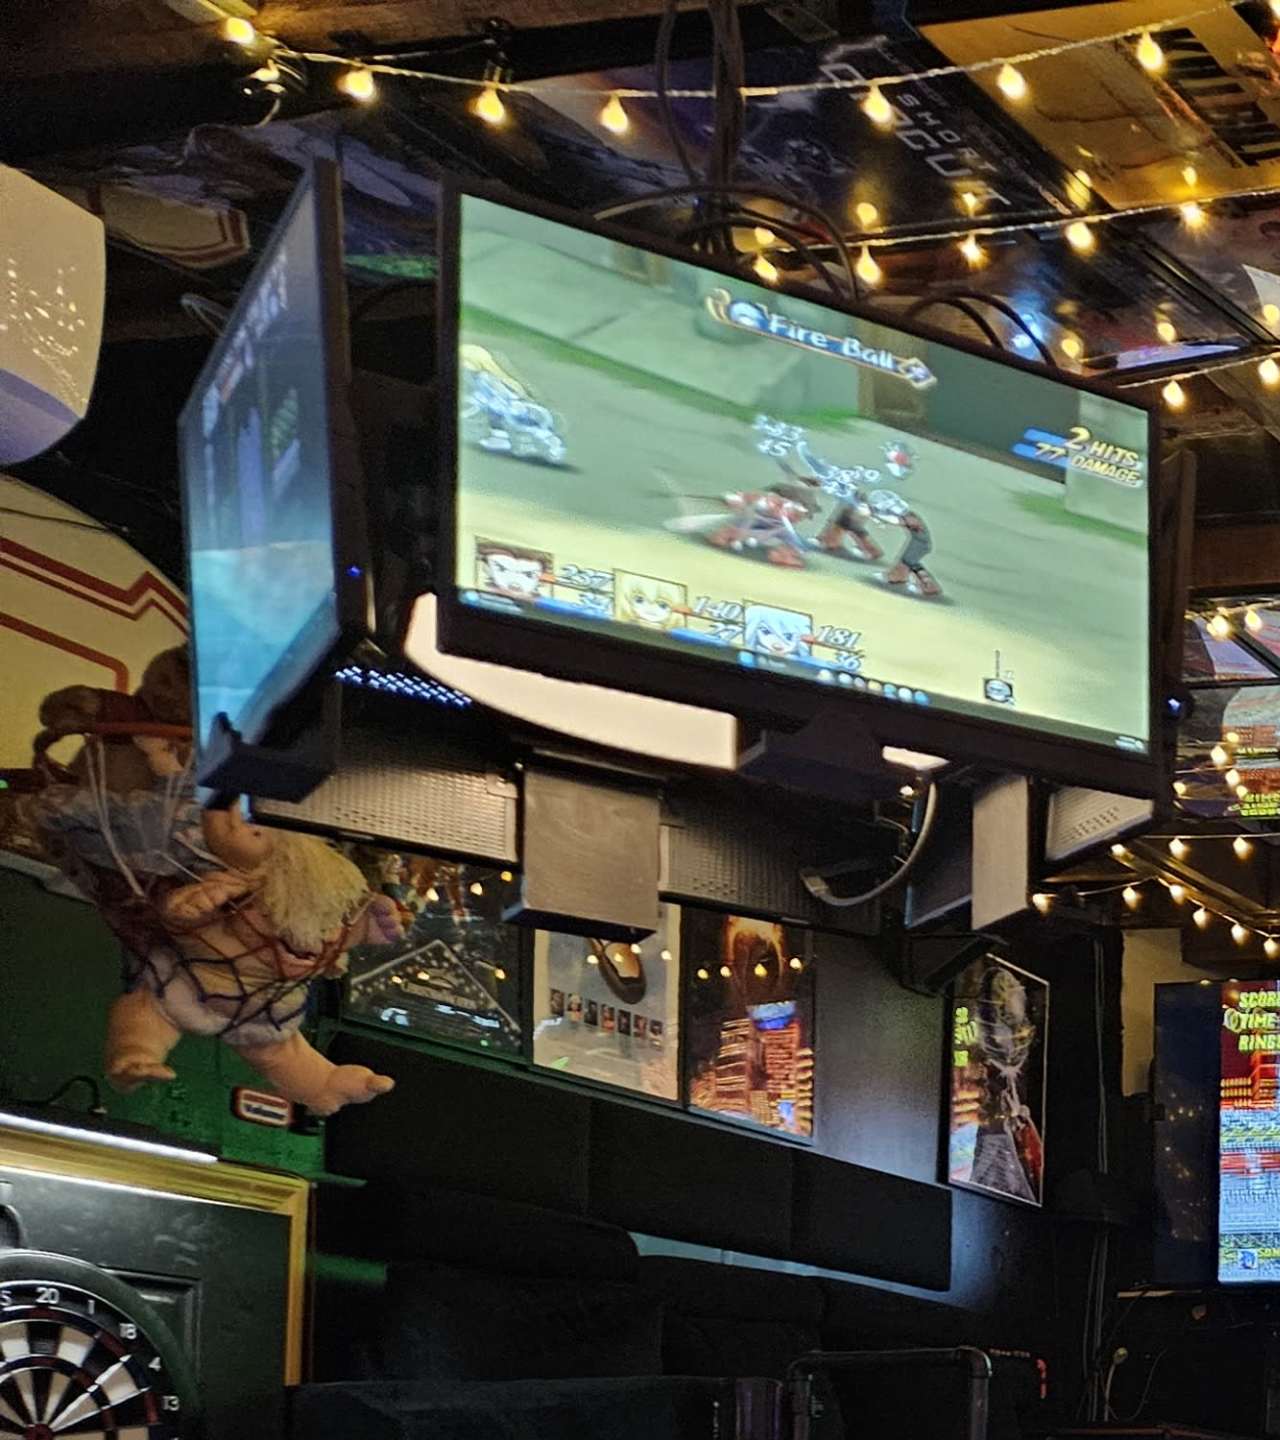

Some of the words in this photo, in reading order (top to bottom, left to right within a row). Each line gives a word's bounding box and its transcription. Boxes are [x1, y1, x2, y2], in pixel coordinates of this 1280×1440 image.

[820, 61, 1013, 206] CCUIT
[896, 94, 998, 174] SHORT
[768, 313, 829, 348] Fire
[841, 336, 895, 369] Ball
[1035, 442, 1068, 460] 77
[1071, 454, 1143, 483] DAMAGE
[1064, 426, 1091, 450] 2
[1090, 441, 1140, 467] HITS
[1240, 1012, 1278, 1029] TIME
[36, 1287, 60, 1304] 20
[88, 1299, 96, 1315] 1
[119, 1322, 137, 1340] 18
[149, 1356, 162, 1371] 4
[163, 1396, 180, 1411] 13
